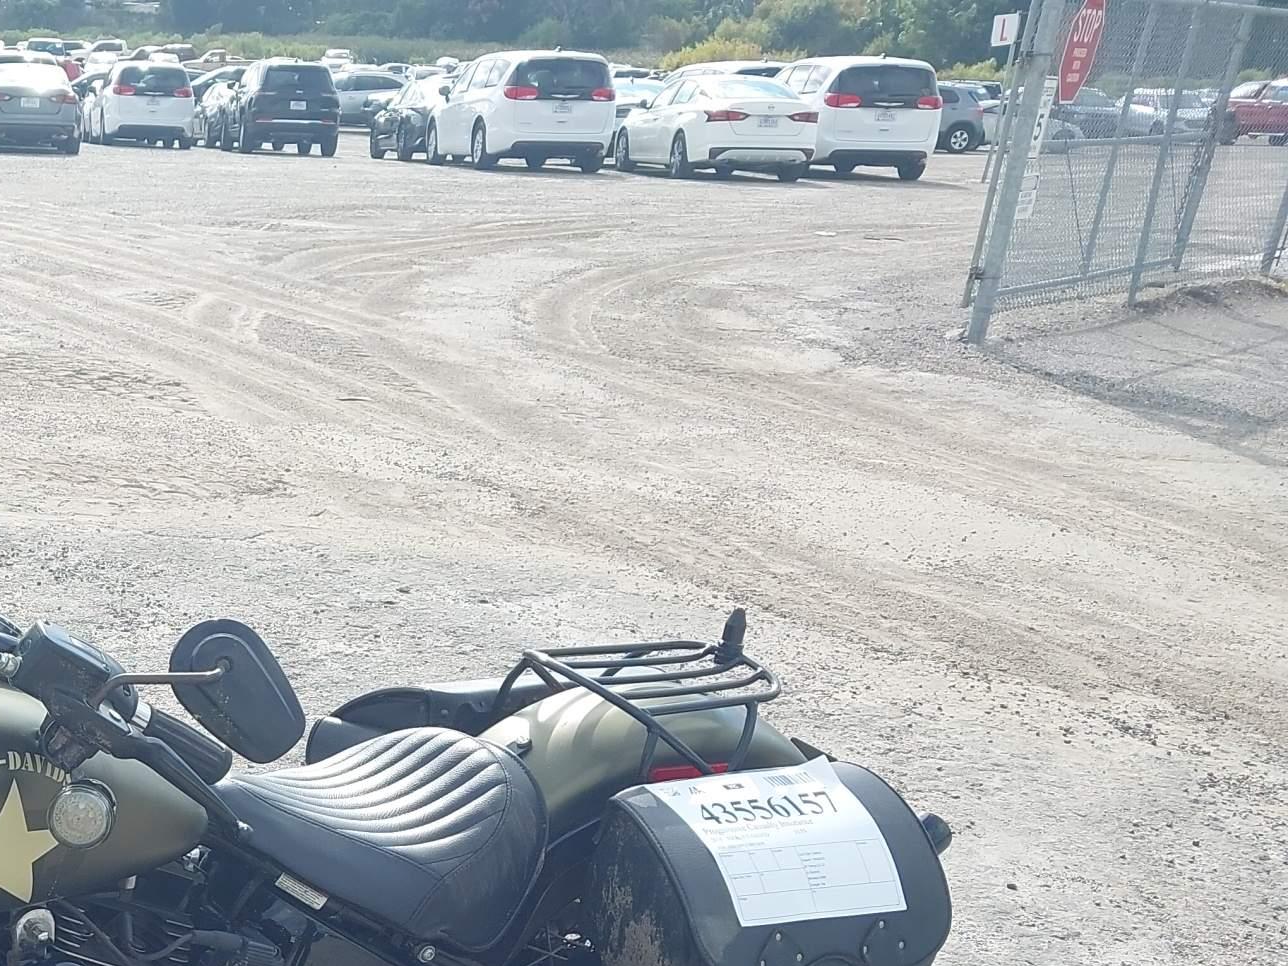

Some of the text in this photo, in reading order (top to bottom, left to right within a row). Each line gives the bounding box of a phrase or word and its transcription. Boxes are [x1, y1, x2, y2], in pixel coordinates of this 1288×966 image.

[999, 18, 1008, 42] L
[1073, 8, 1102, 43] STOP
[1032, 112, 1045, 141] 5
[700, 791, 838, 825] 43556157
